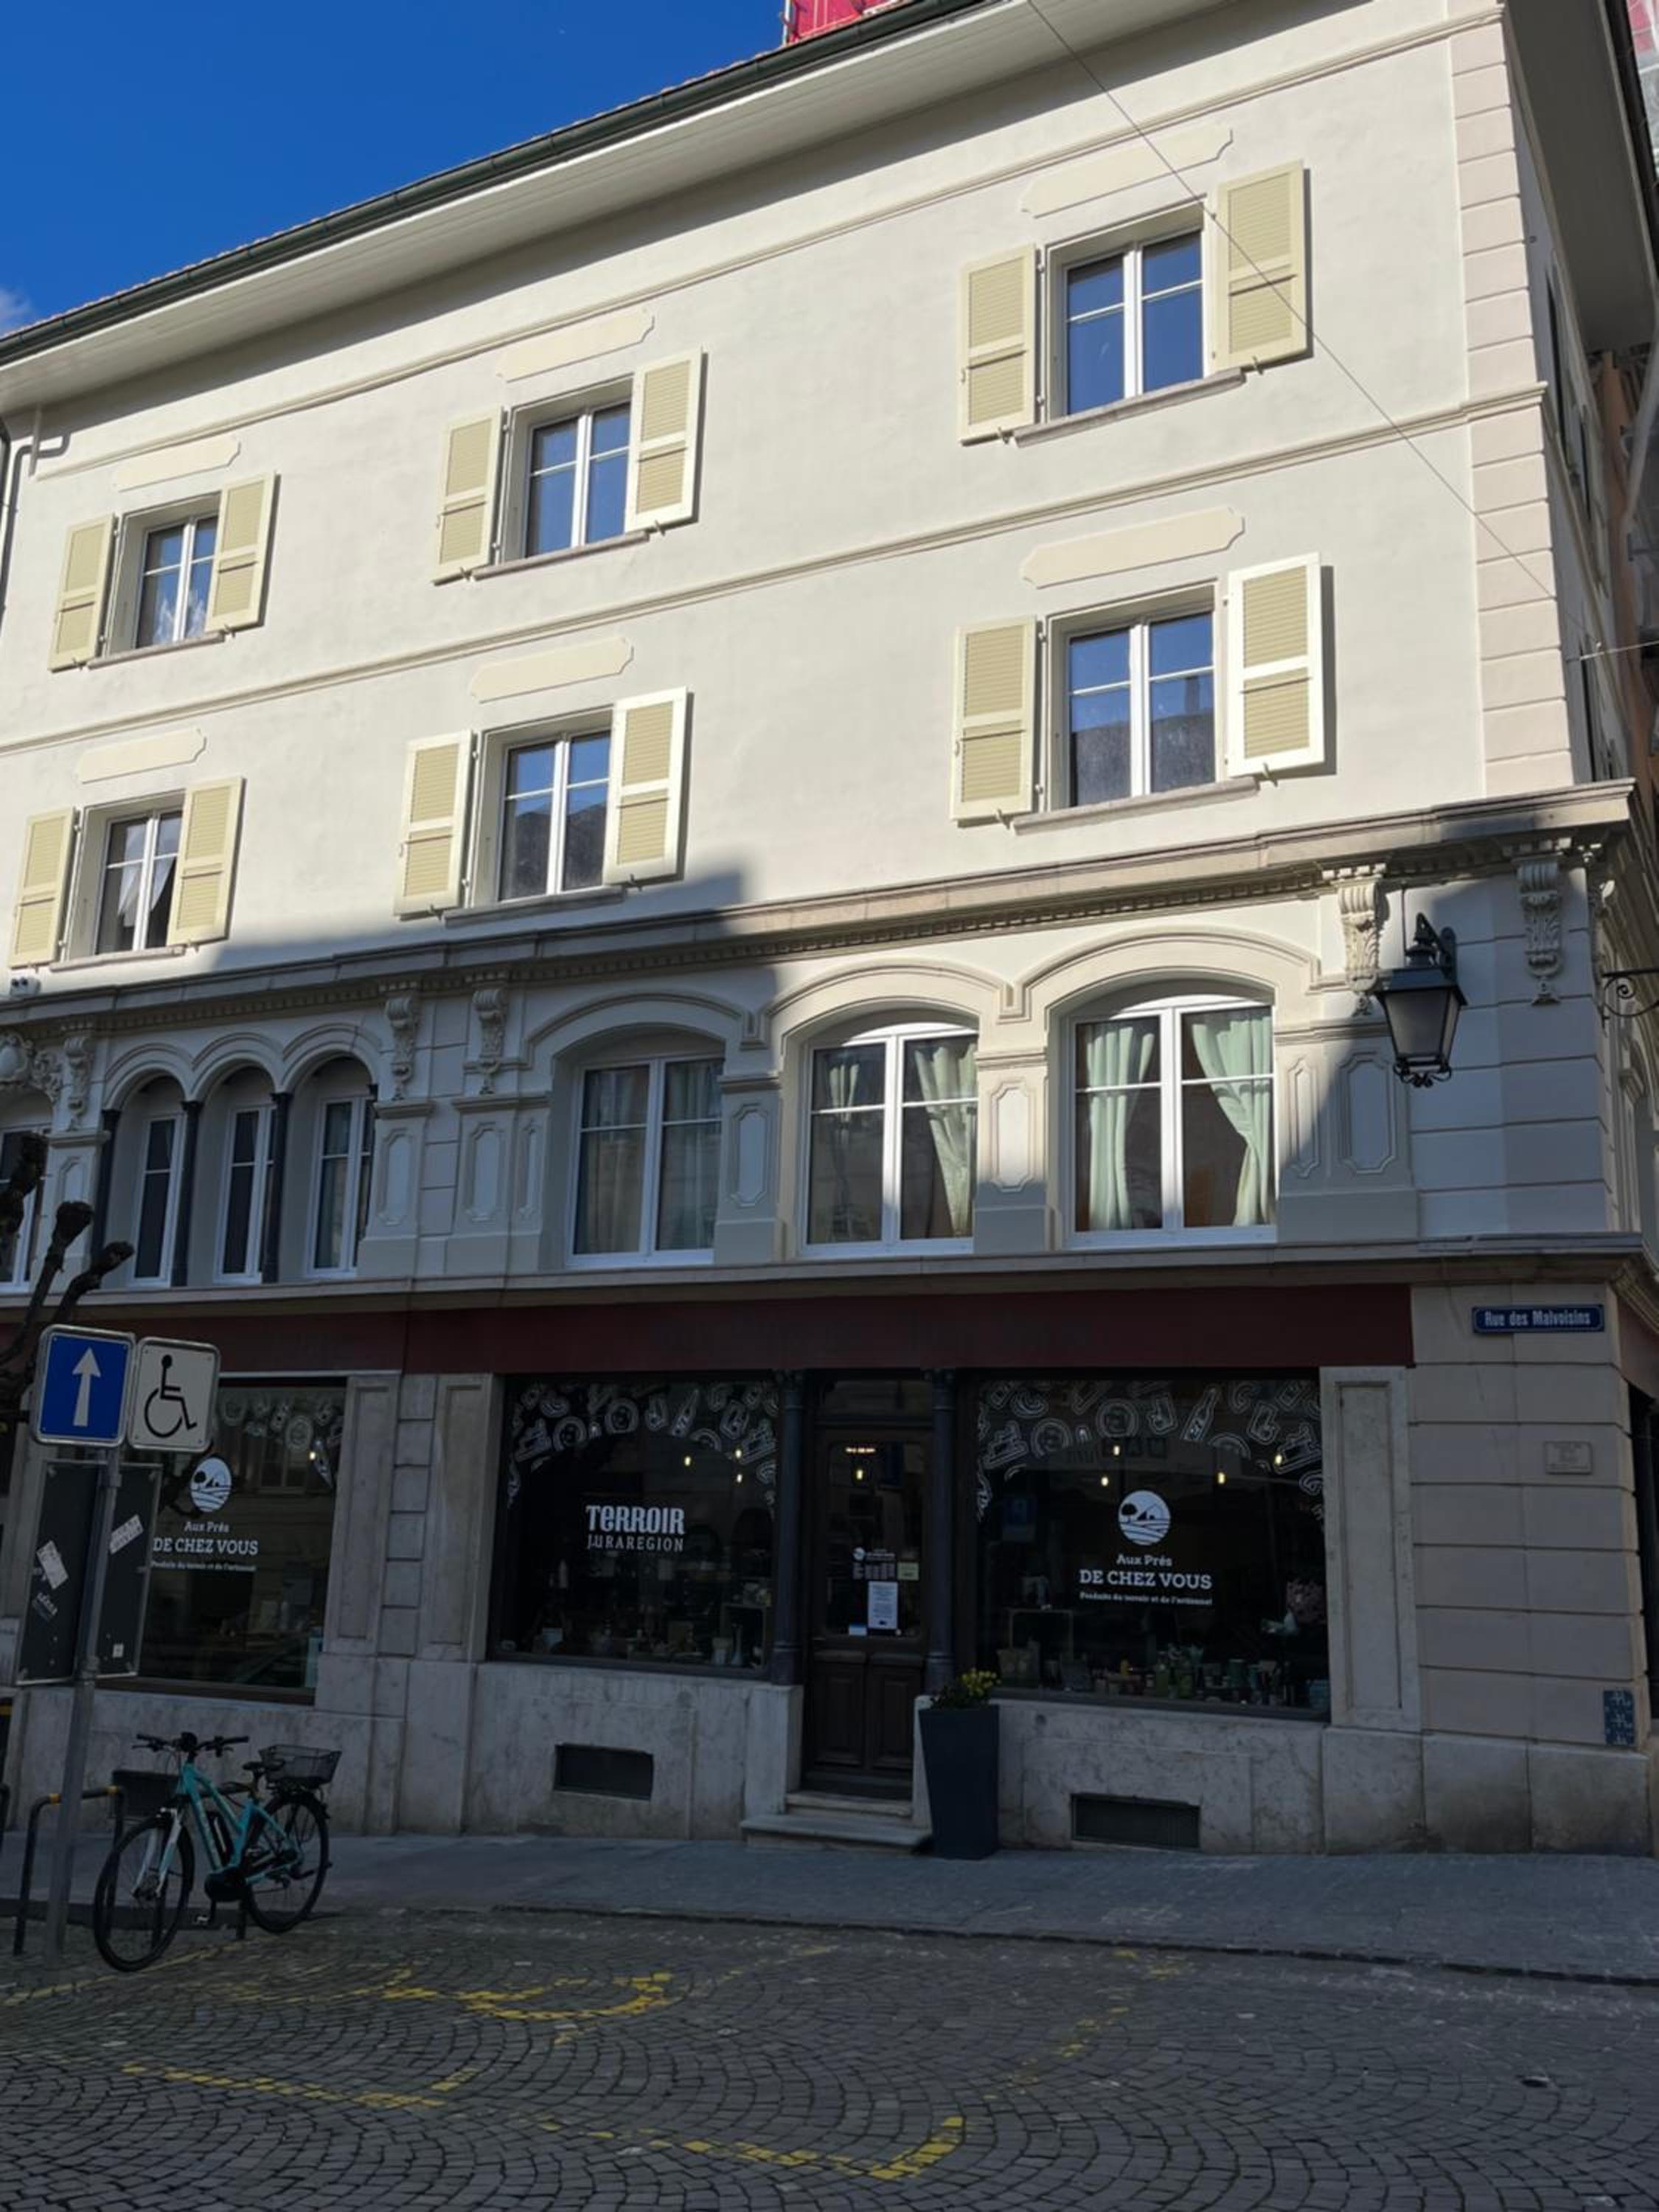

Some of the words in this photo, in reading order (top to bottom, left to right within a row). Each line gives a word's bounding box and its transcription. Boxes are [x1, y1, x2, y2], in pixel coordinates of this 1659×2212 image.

[1484, 1310, 1505, 1326] Rue
[1509, 1310, 1528, 1326] des
[1532, 1309, 1591, 1326] Malvoisins
[184, 1520, 205, 1532] Aux
[153, 1537, 173, 1552] DE
[175, 1537, 214, 1554] CHEZ
[217, 1539, 259, 1556] VOUS
[1116, 1553, 1142, 1565] Aux
[1144, 1554, 1172, 1567] Prés
[1079, 1568, 1104, 1585] DE
[1107, 1570, 1156, 1587] CHEZ
[1158, 1572, 1213, 1590] VOUS
